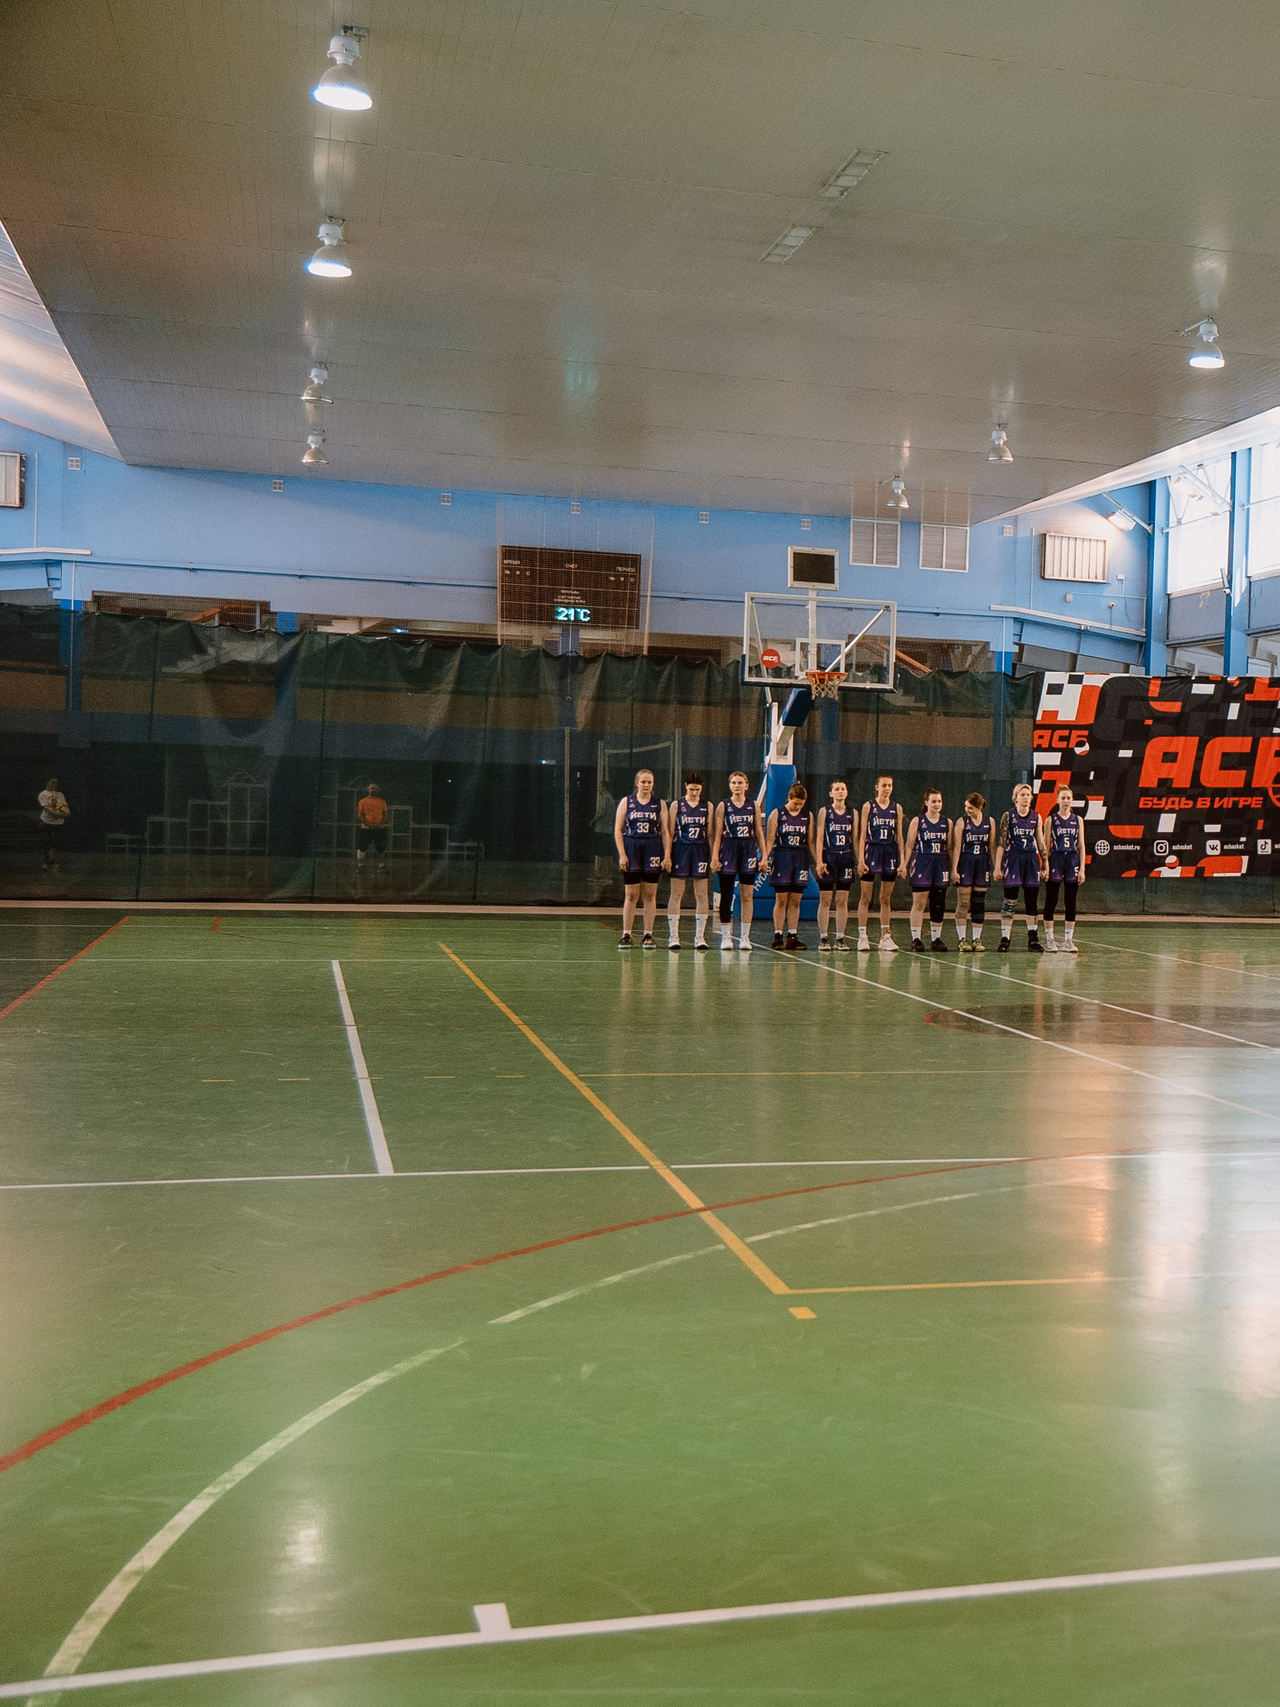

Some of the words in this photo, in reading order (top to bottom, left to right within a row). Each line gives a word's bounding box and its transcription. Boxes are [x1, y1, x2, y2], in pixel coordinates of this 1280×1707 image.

[1139, 797, 1194, 810] БУДЬ
[1197, 797, 1211, 808] В
[1214, 796, 1263, 809] ИГРЕ
[637, 822, 649, 833] 33
[688, 827, 700, 838] 27
[737, 826, 749, 837] 22
[879, 829, 888, 839] 11
[836, 835, 846, 846] 13
[1021, 839, 1028, 849] 7
[1063, 837, 1070, 848] 5
[931, 843, 941, 853] 10
[973, 845, 980, 855] 8
[650, 856, 660, 867] 33
[748, 857, 757, 869] 22
[698, 862, 708, 873] 27
[844, 868, 853, 879] 13
